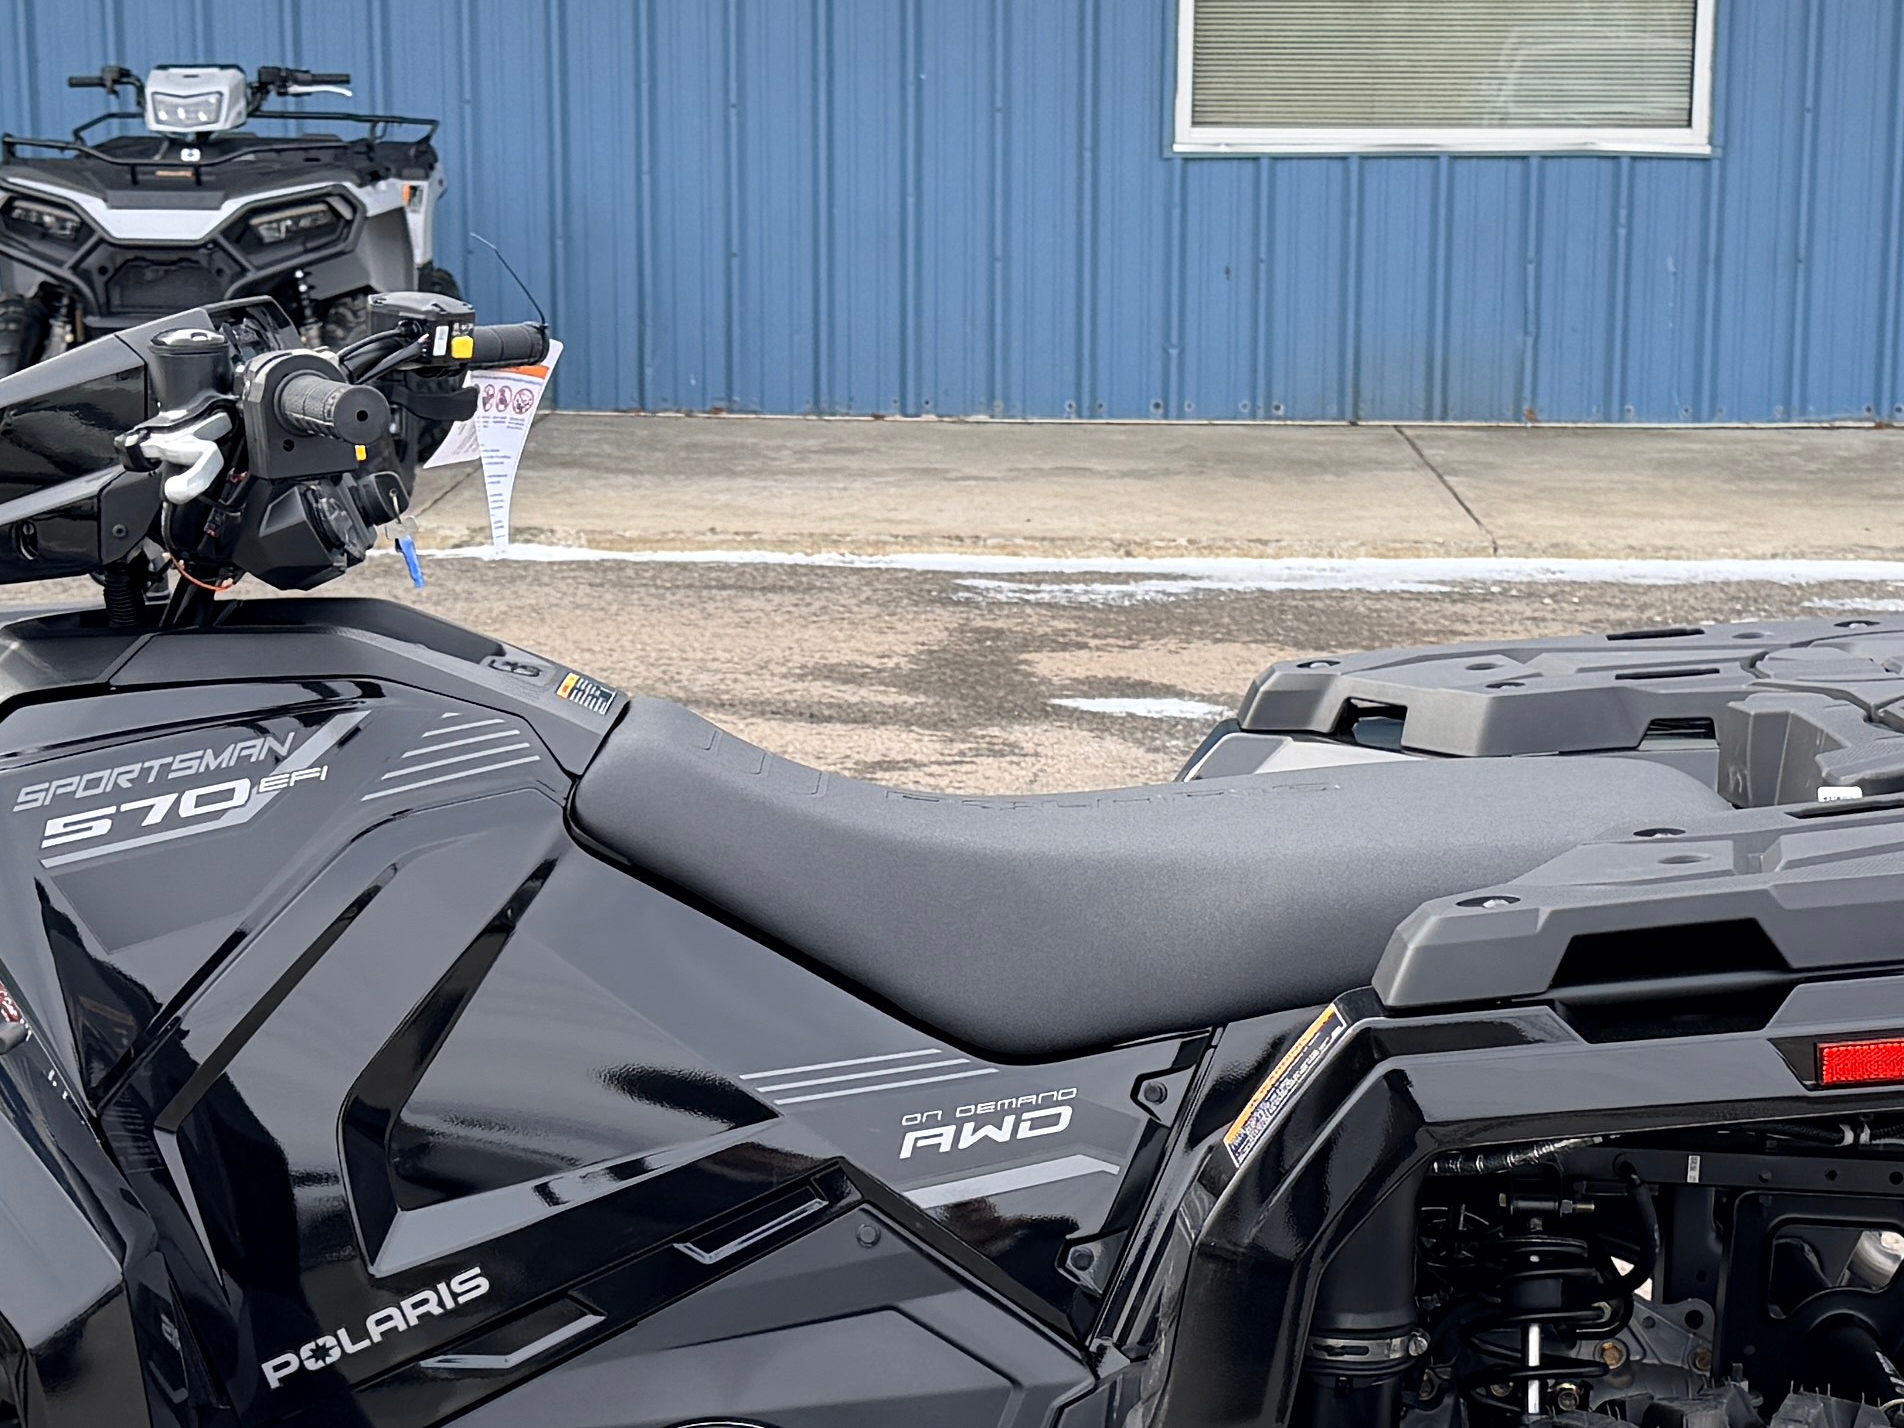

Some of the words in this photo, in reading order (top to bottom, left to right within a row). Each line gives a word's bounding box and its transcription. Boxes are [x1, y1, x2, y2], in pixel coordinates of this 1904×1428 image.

[12, 731, 295, 812] SPORTSMAN
[41, 778, 251, 839] 570
[258, 765, 329, 794] EFI
[899, 1105, 1073, 1159] AWD
[901, 1110, 943, 1126] ON
[955, 1087, 1077, 1118] DEMAND
[261, 1266, 490, 1389] POLARIS
